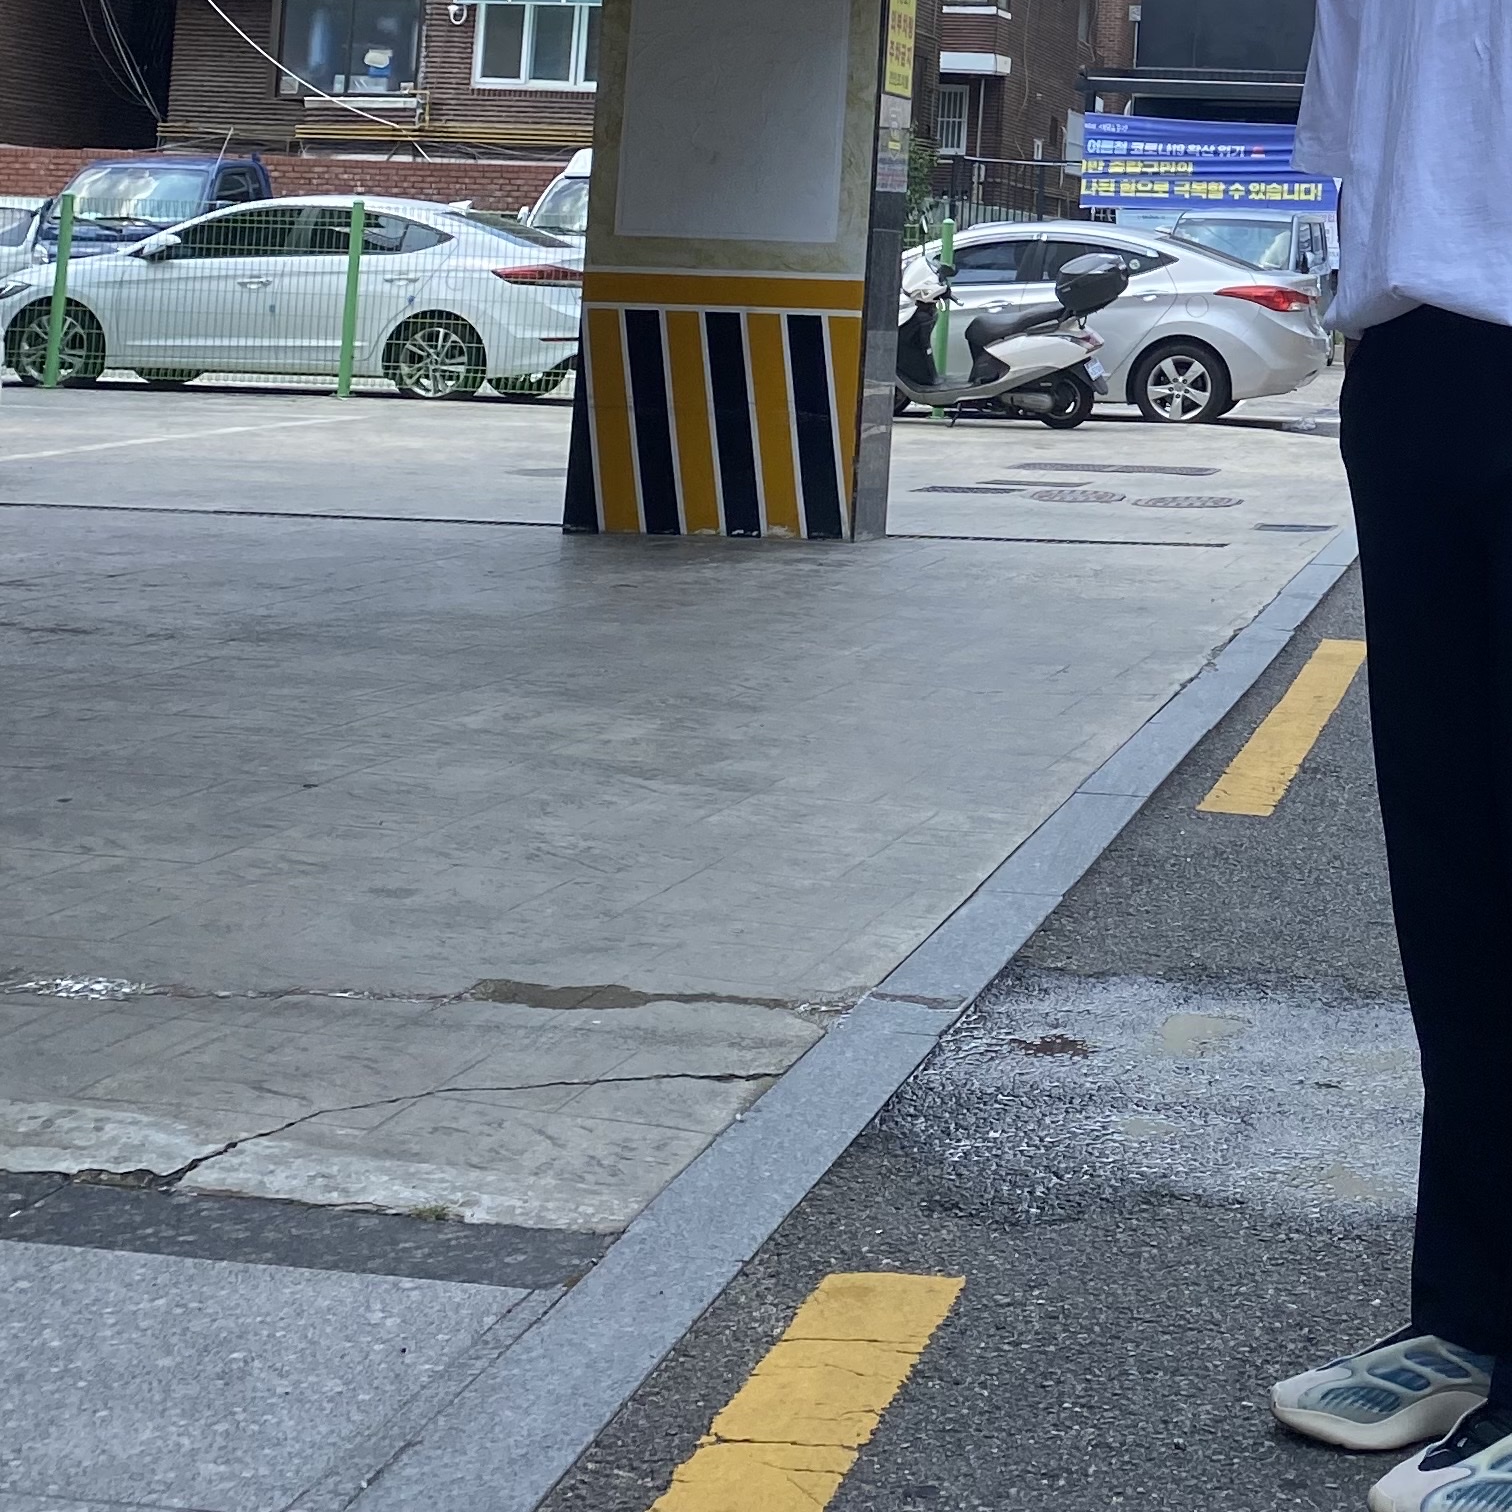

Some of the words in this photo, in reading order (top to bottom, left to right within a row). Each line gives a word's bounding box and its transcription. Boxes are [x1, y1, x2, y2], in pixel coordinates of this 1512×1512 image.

[888, 39, 912, 69] 주차금지
[1087, 139, 1128, 156] 여름철
[1130, 141, 1186, 156] 코로나19
[1120, 179, 1170, 198] 힘으로
[1173, 180, 1226, 199] 극복할
[1228, 183, 1246, 199] 수
[1248, 181, 1323, 202] 있습니다!
